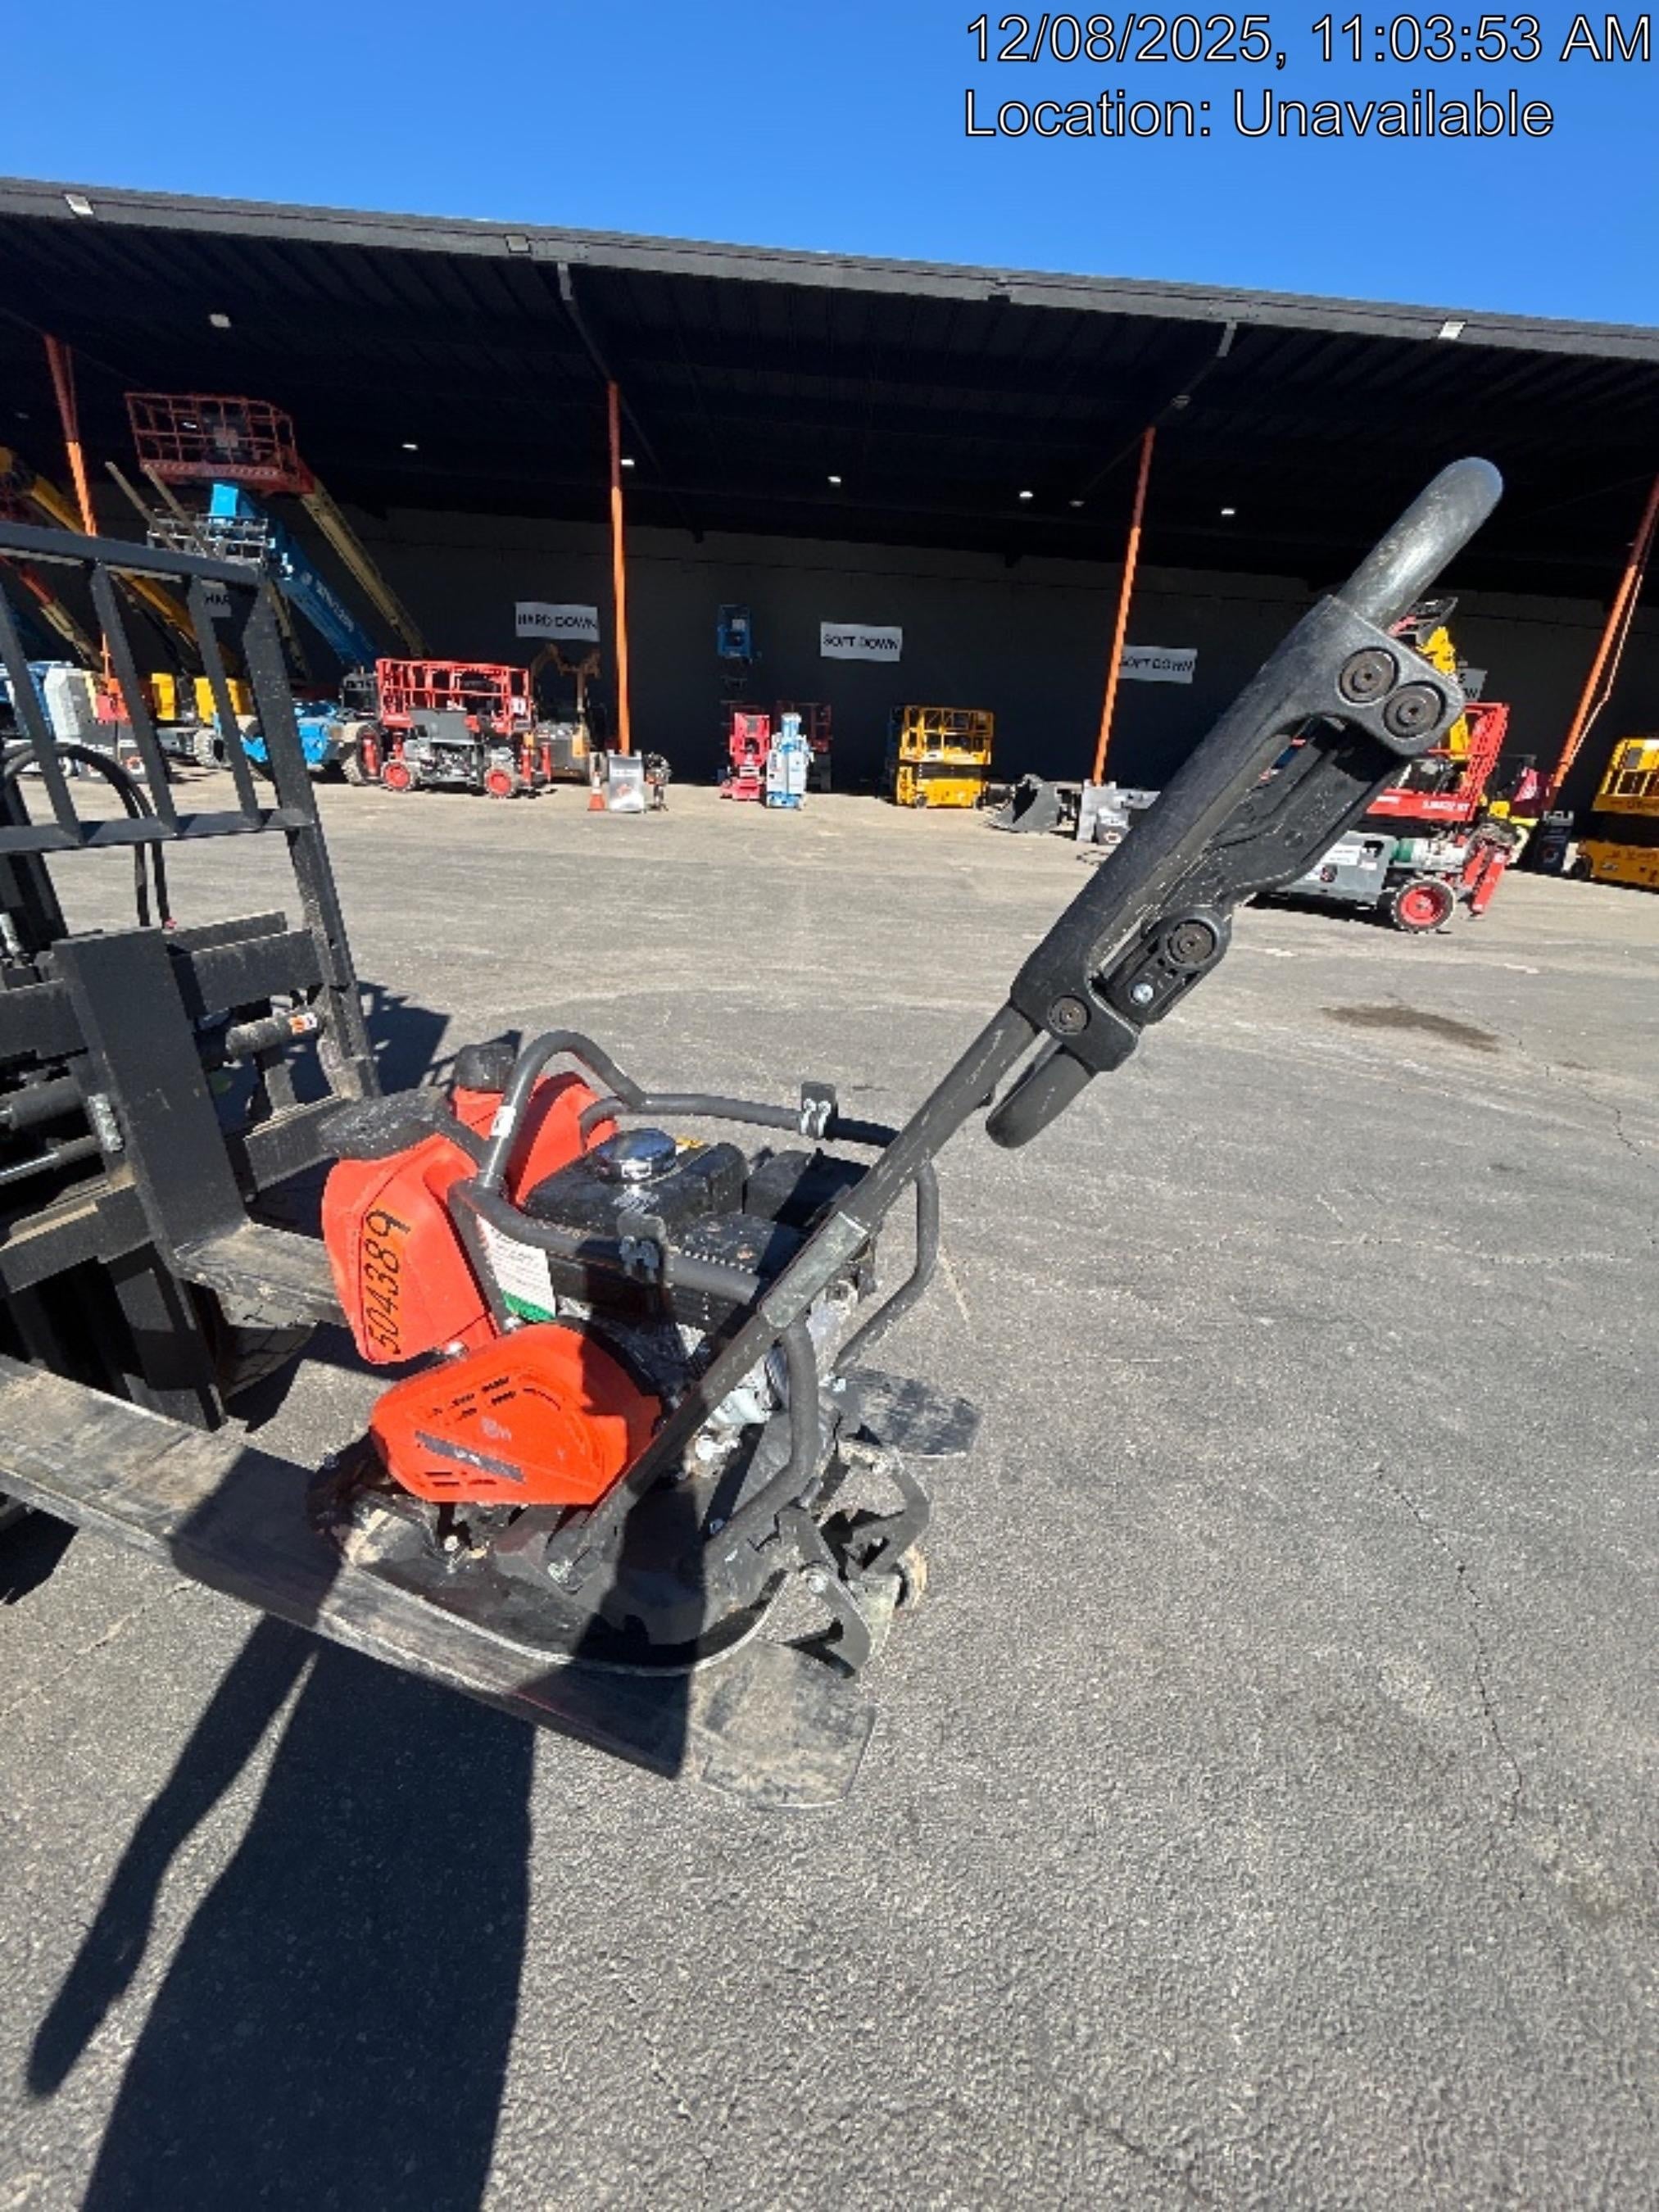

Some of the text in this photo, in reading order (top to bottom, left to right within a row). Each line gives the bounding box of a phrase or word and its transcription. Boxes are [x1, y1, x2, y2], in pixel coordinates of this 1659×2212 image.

[517, 614, 597, 629] HARD DOWN
[823, 633, 898, 650] SOFT DOWN
[1153, 658, 1194, 672] DOWN
[365, 1209, 411, 1354] 504389
